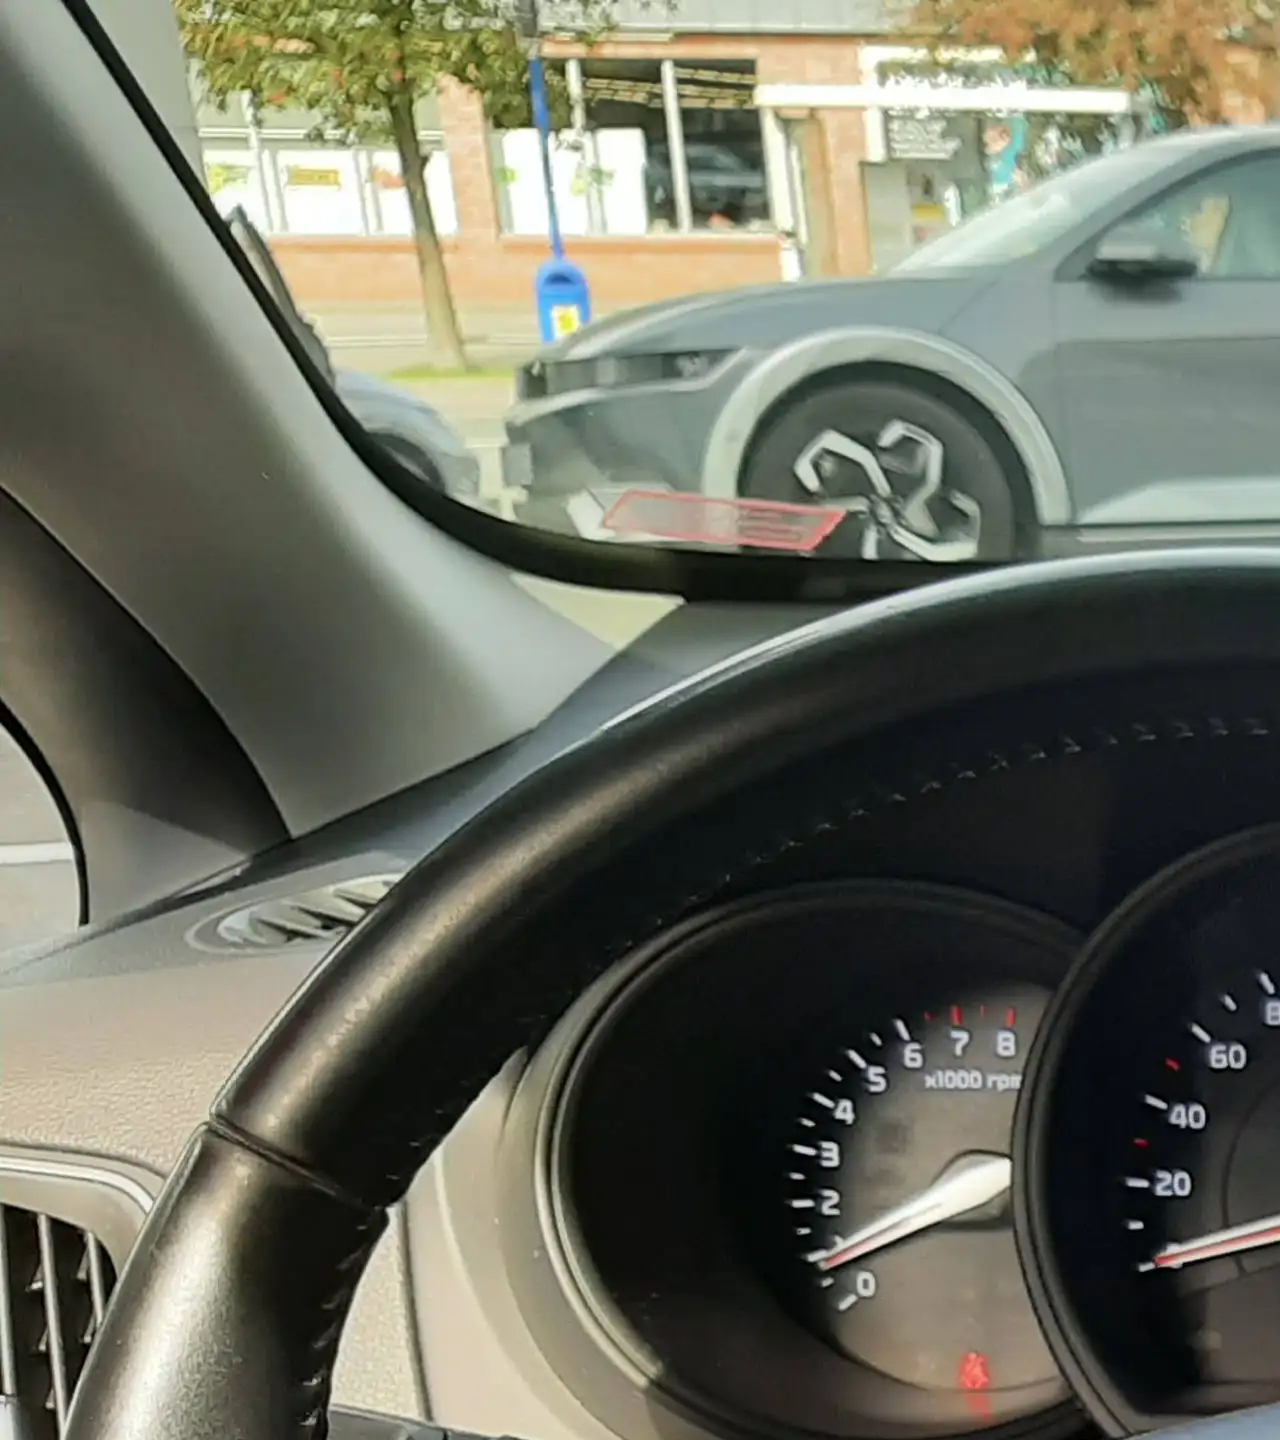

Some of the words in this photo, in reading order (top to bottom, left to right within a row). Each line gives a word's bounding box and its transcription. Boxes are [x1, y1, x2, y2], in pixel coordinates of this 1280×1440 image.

[903, 1043, 923, 1068] 6
[950, 1031, 970, 1057] 7
[997, 1031, 1016, 1057] 8
[1208, 1044, 1246, 1069] 60
[867, 1068, 886, 1093] 5
[925, 1071, 982, 1089] x1000
[834, 1100, 855, 1124] 4
[1169, 1105, 1206, 1130] 40
[820, 1142, 840, 1168] 3
[1153, 1172, 1191, 1197] 20
[820, 1190, 841, 1216] 2
[856, 1272, 876, 1297] 0
